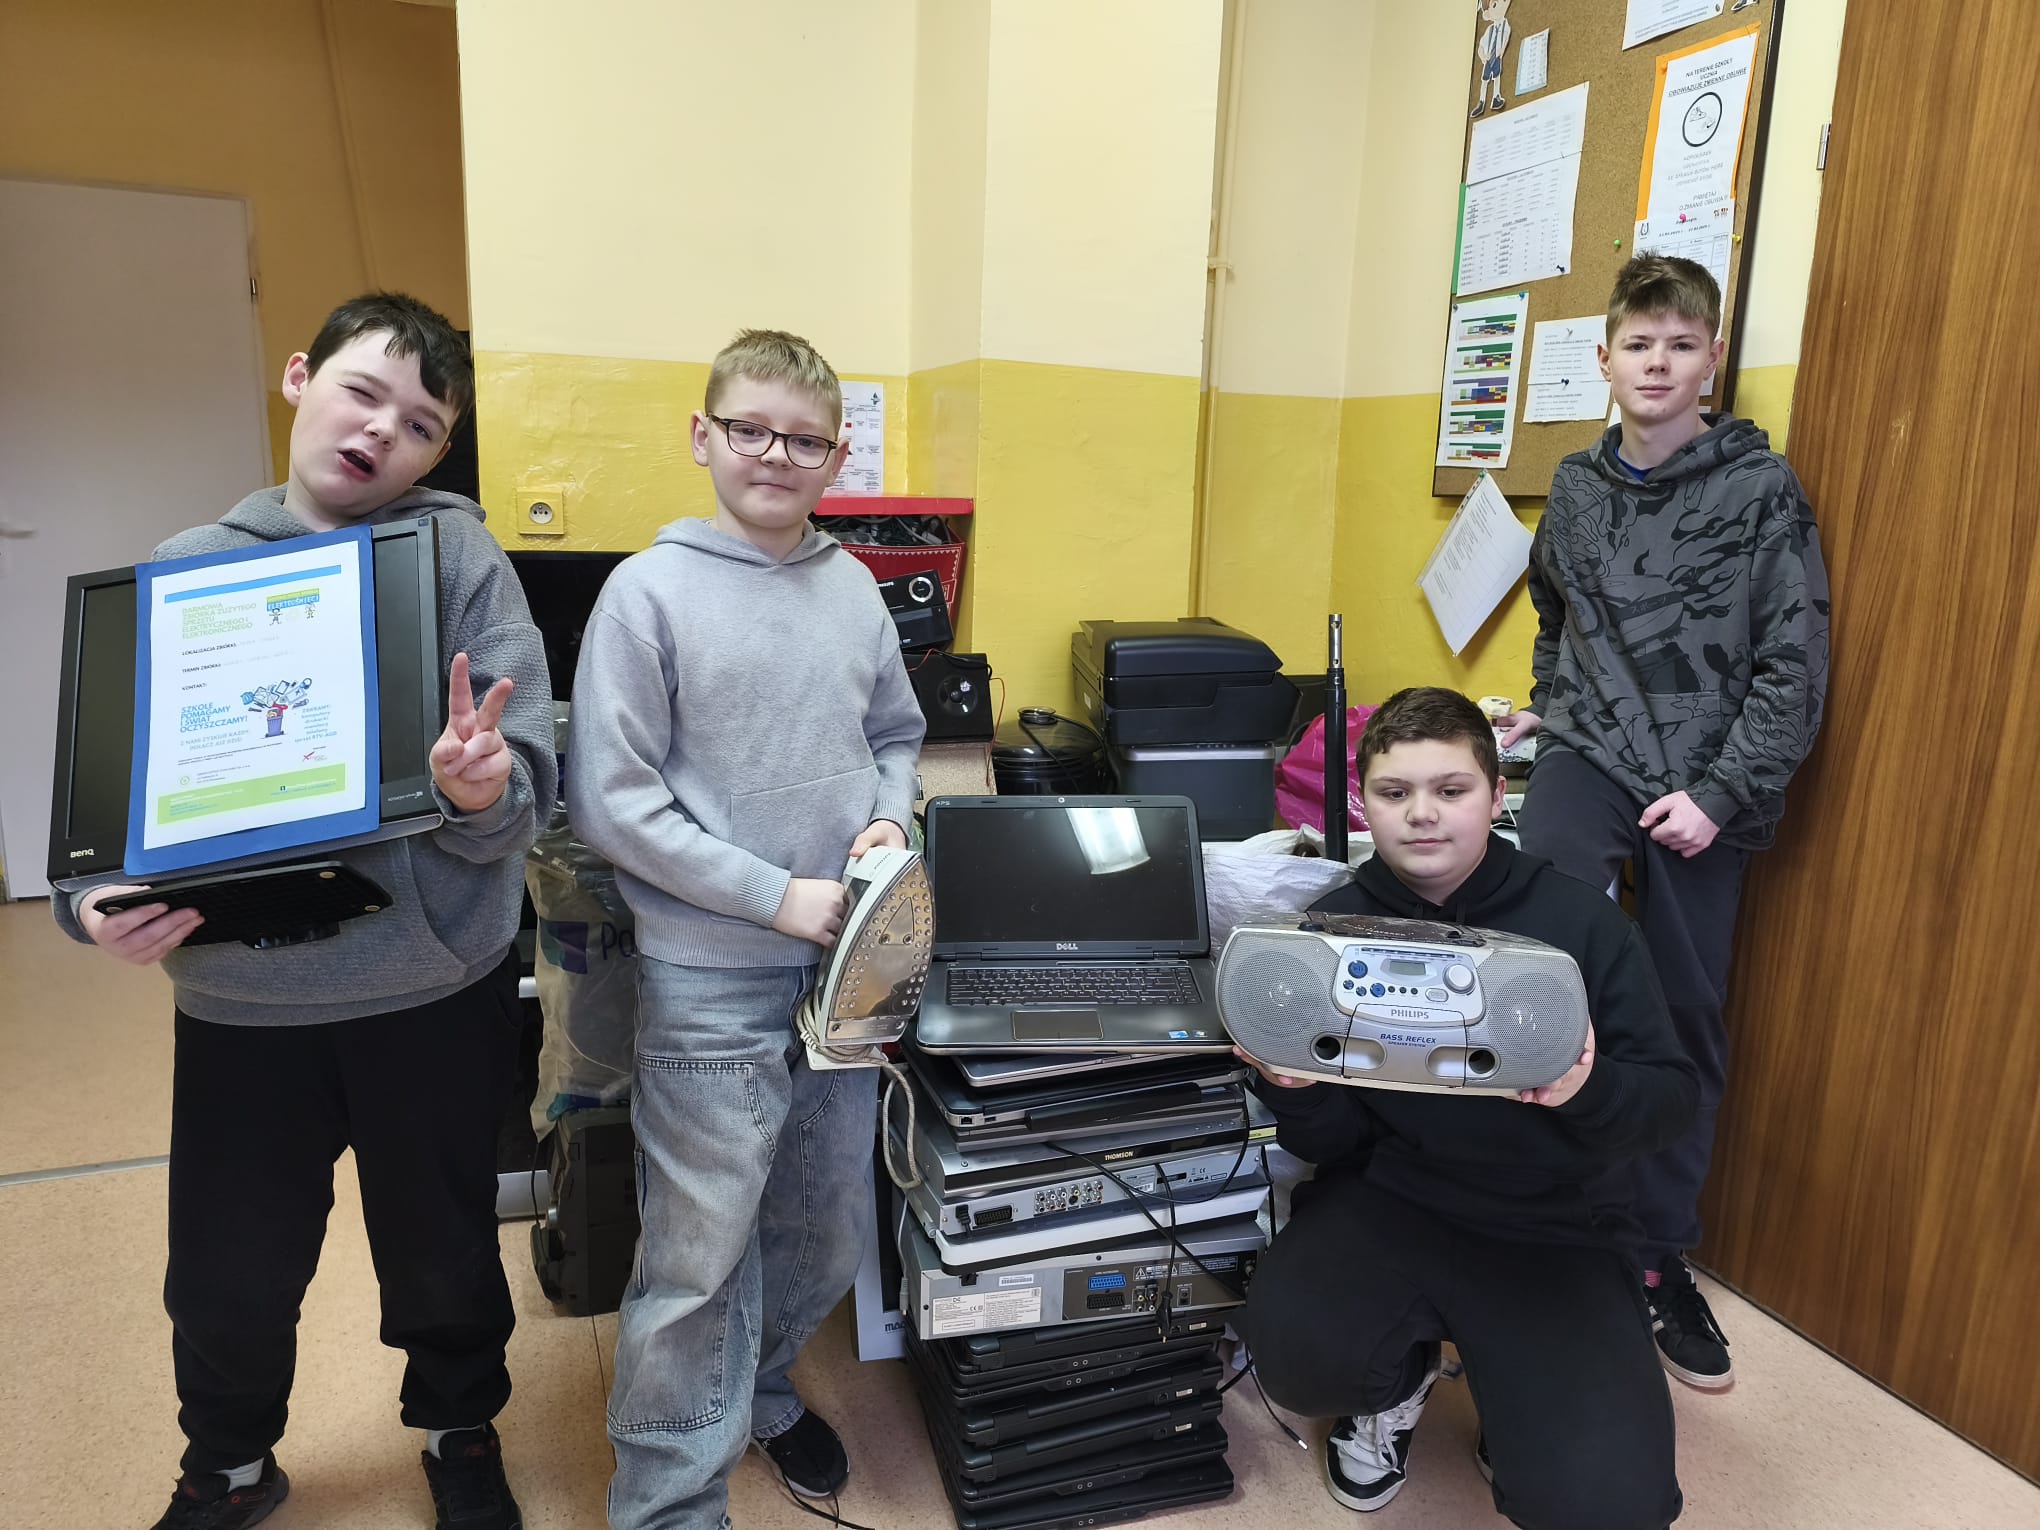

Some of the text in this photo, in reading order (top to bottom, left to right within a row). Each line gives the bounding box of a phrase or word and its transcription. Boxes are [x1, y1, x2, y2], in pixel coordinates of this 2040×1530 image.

[1056, 942, 1078, 951] DELL
[1391, 1009, 1429, 1019] PHILIPS
[1380, 1033, 1436, 1044] BASS REFLEX
[1104, 1150, 1134, 1161] THOMSON
